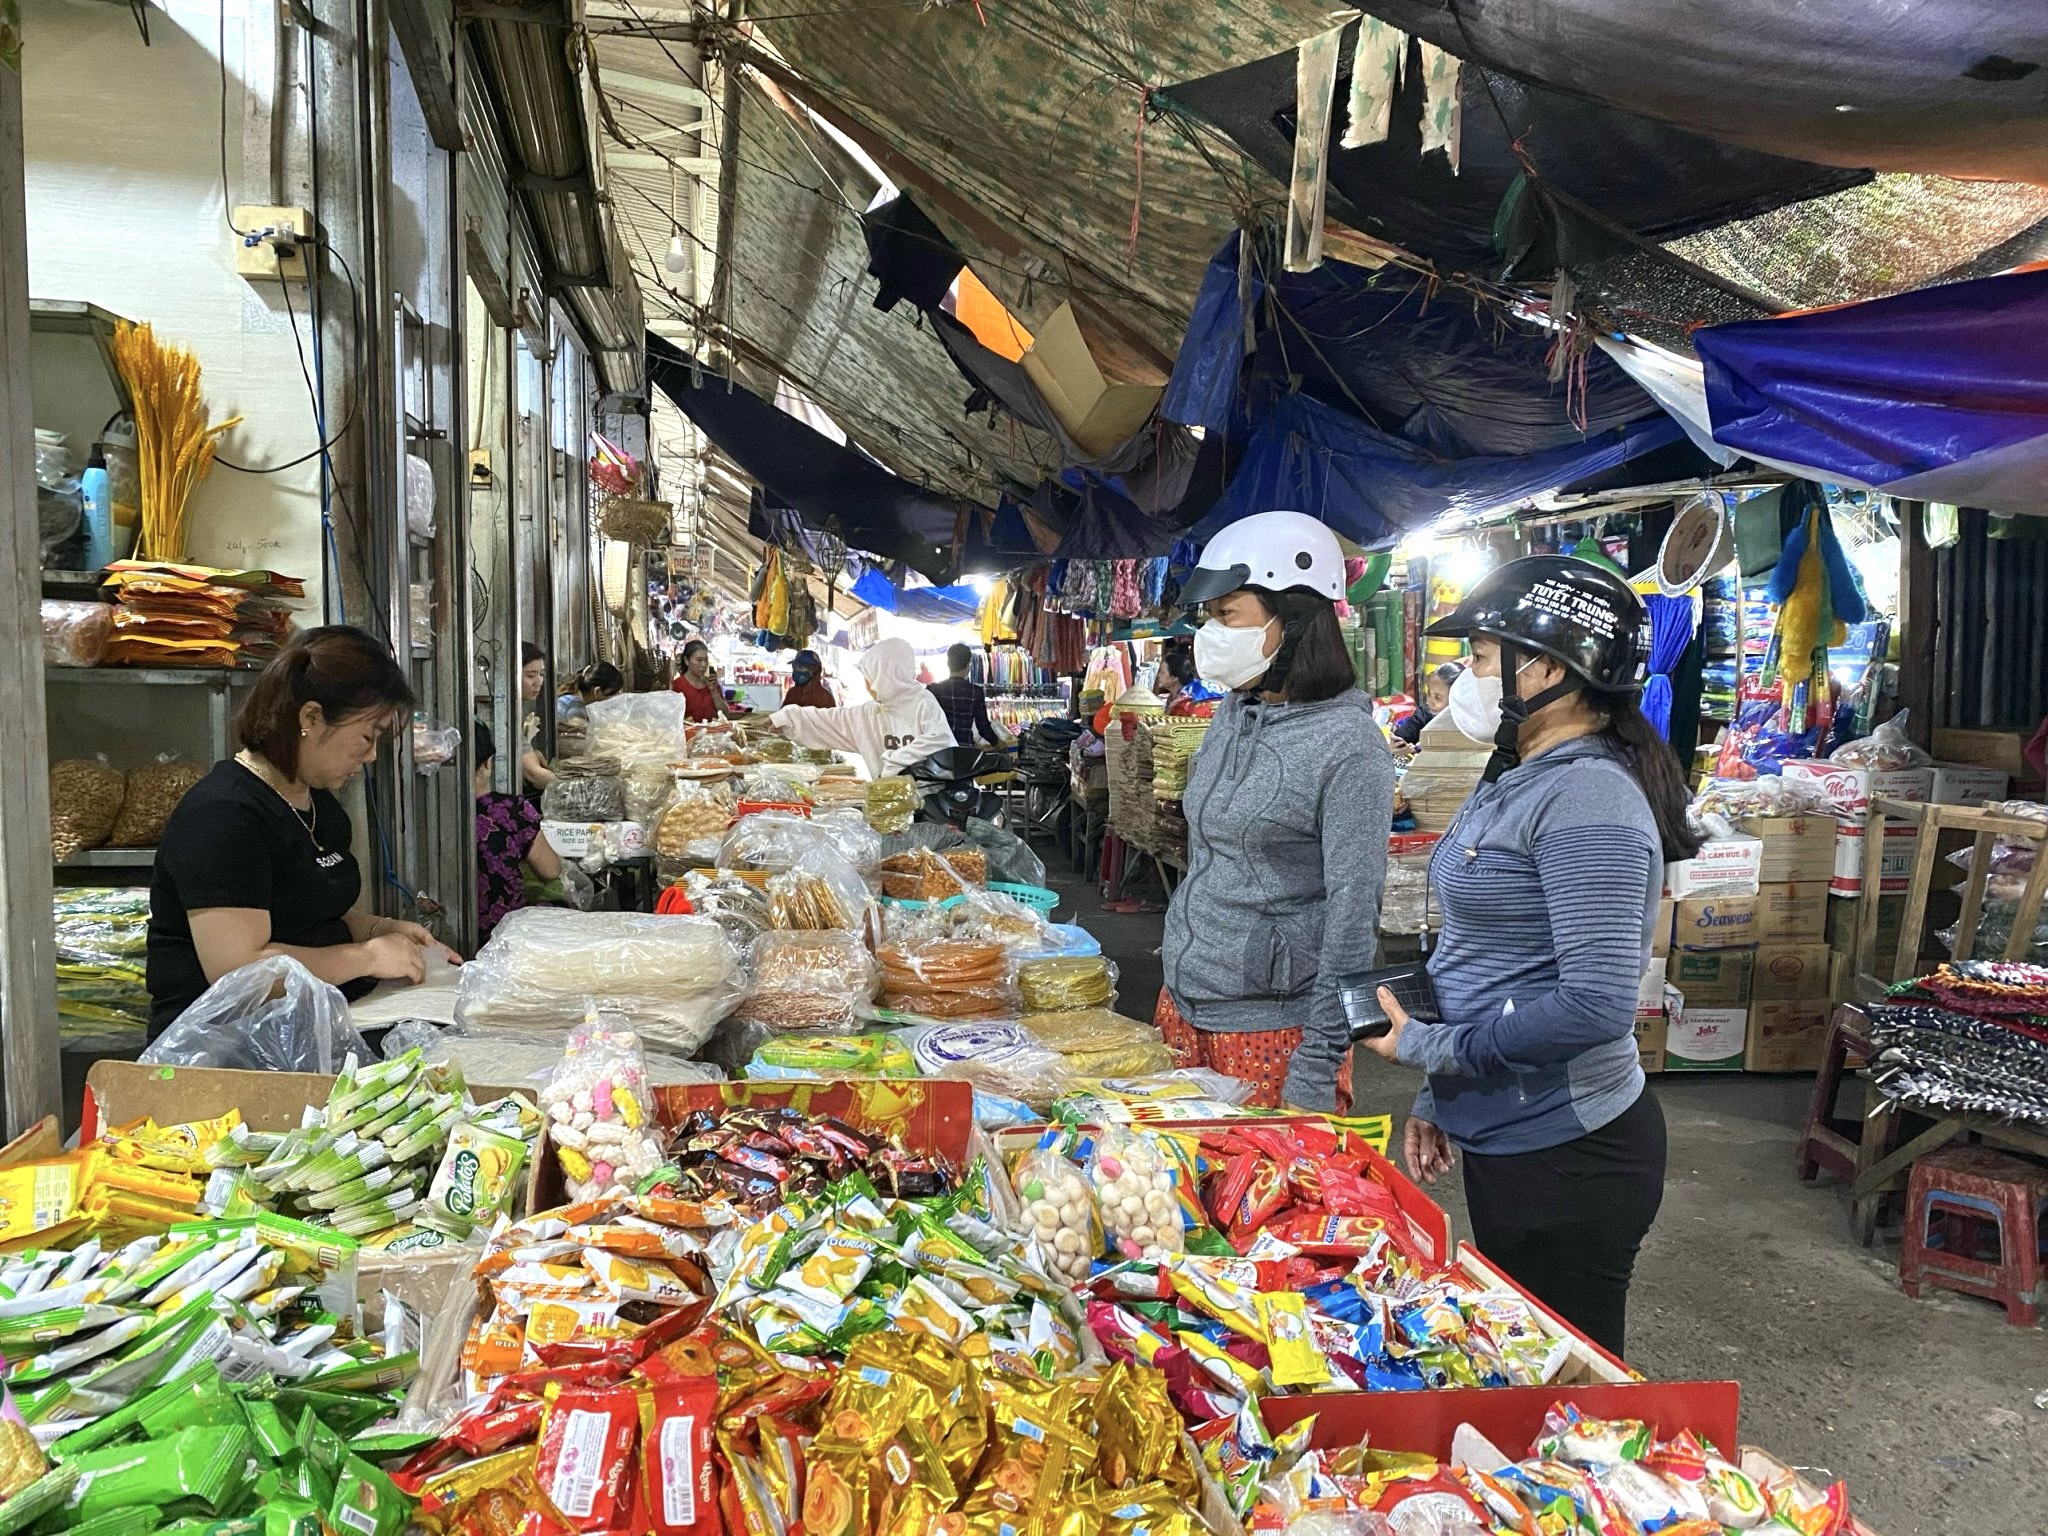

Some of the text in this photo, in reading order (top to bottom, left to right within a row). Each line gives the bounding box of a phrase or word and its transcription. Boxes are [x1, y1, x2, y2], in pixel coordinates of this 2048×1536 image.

[1531, 583, 1617, 623] TUYẾT TRUNG
[556, 828, 573, 836] RICE
[828, 1238, 877, 1252] DURIAN
